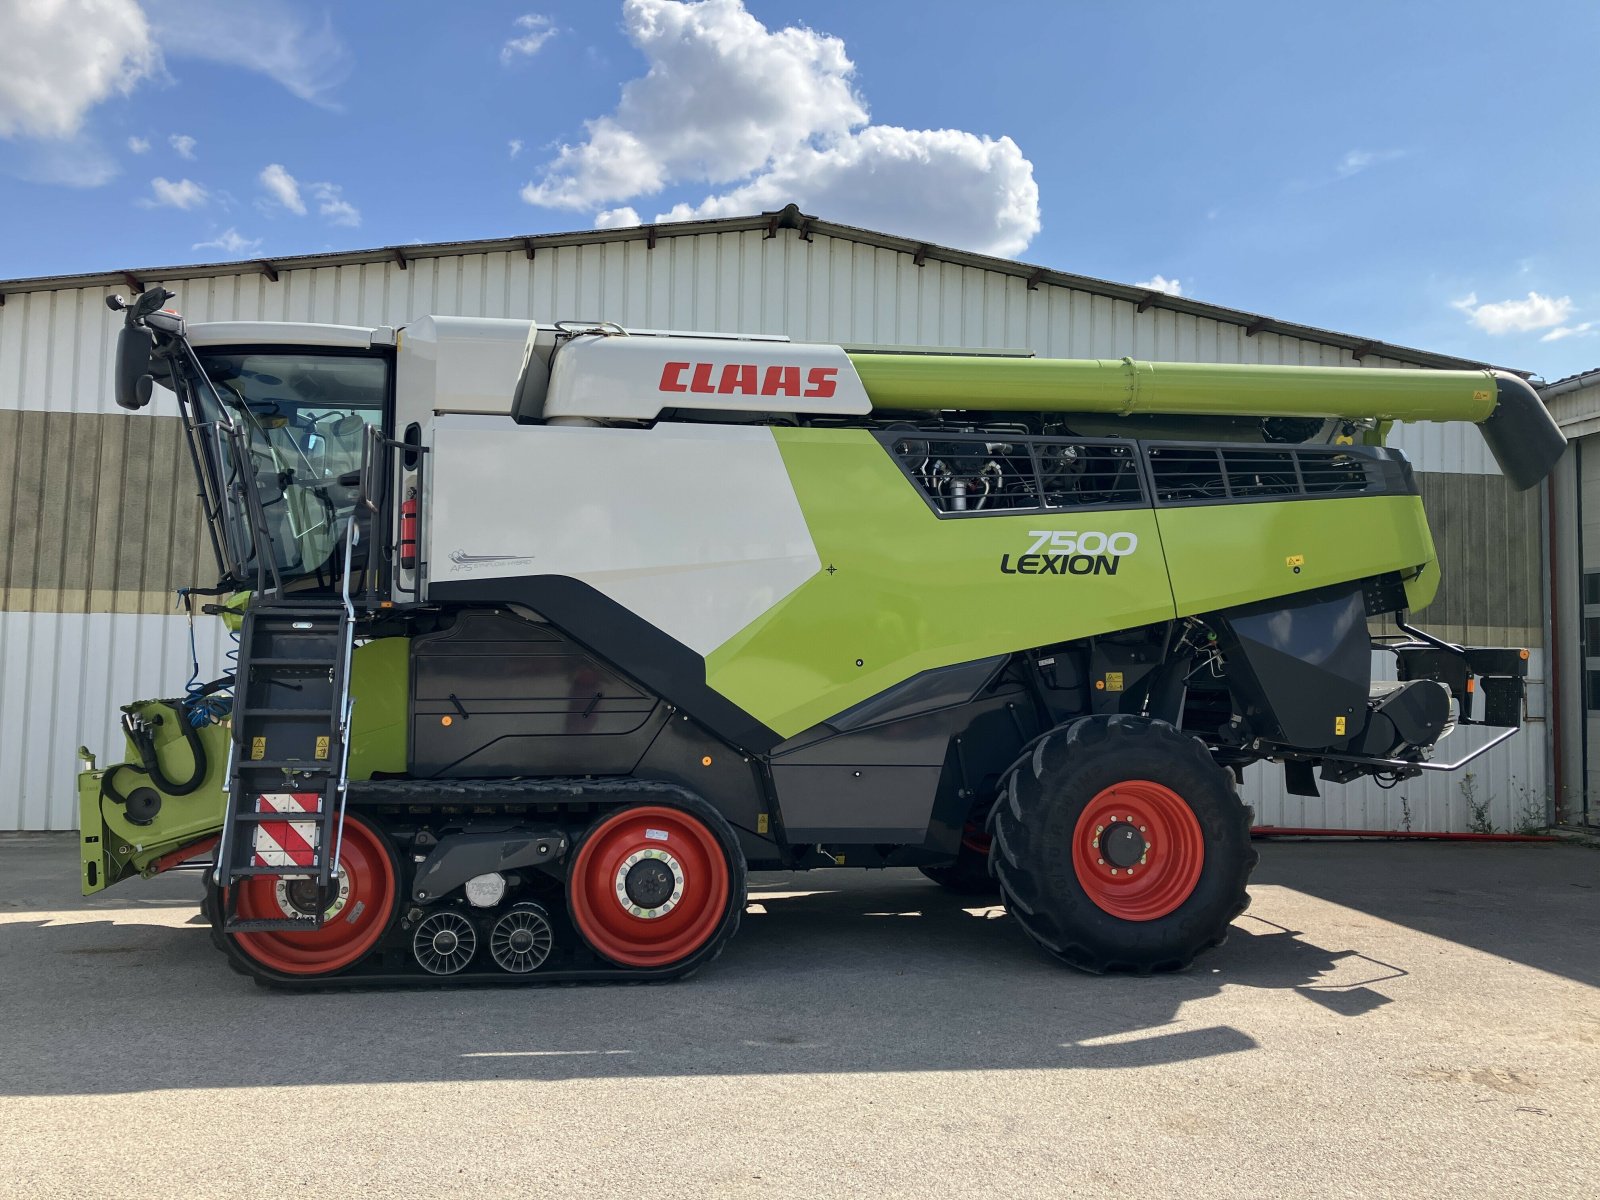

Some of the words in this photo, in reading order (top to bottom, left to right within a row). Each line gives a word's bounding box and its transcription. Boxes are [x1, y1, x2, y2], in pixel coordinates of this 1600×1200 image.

[659, 362, 838, 397] CLAAS
[1025, 531, 1137, 556] 7500
[450, 564, 472, 573] APS
[1001, 553, 1120, 575] LEXION
